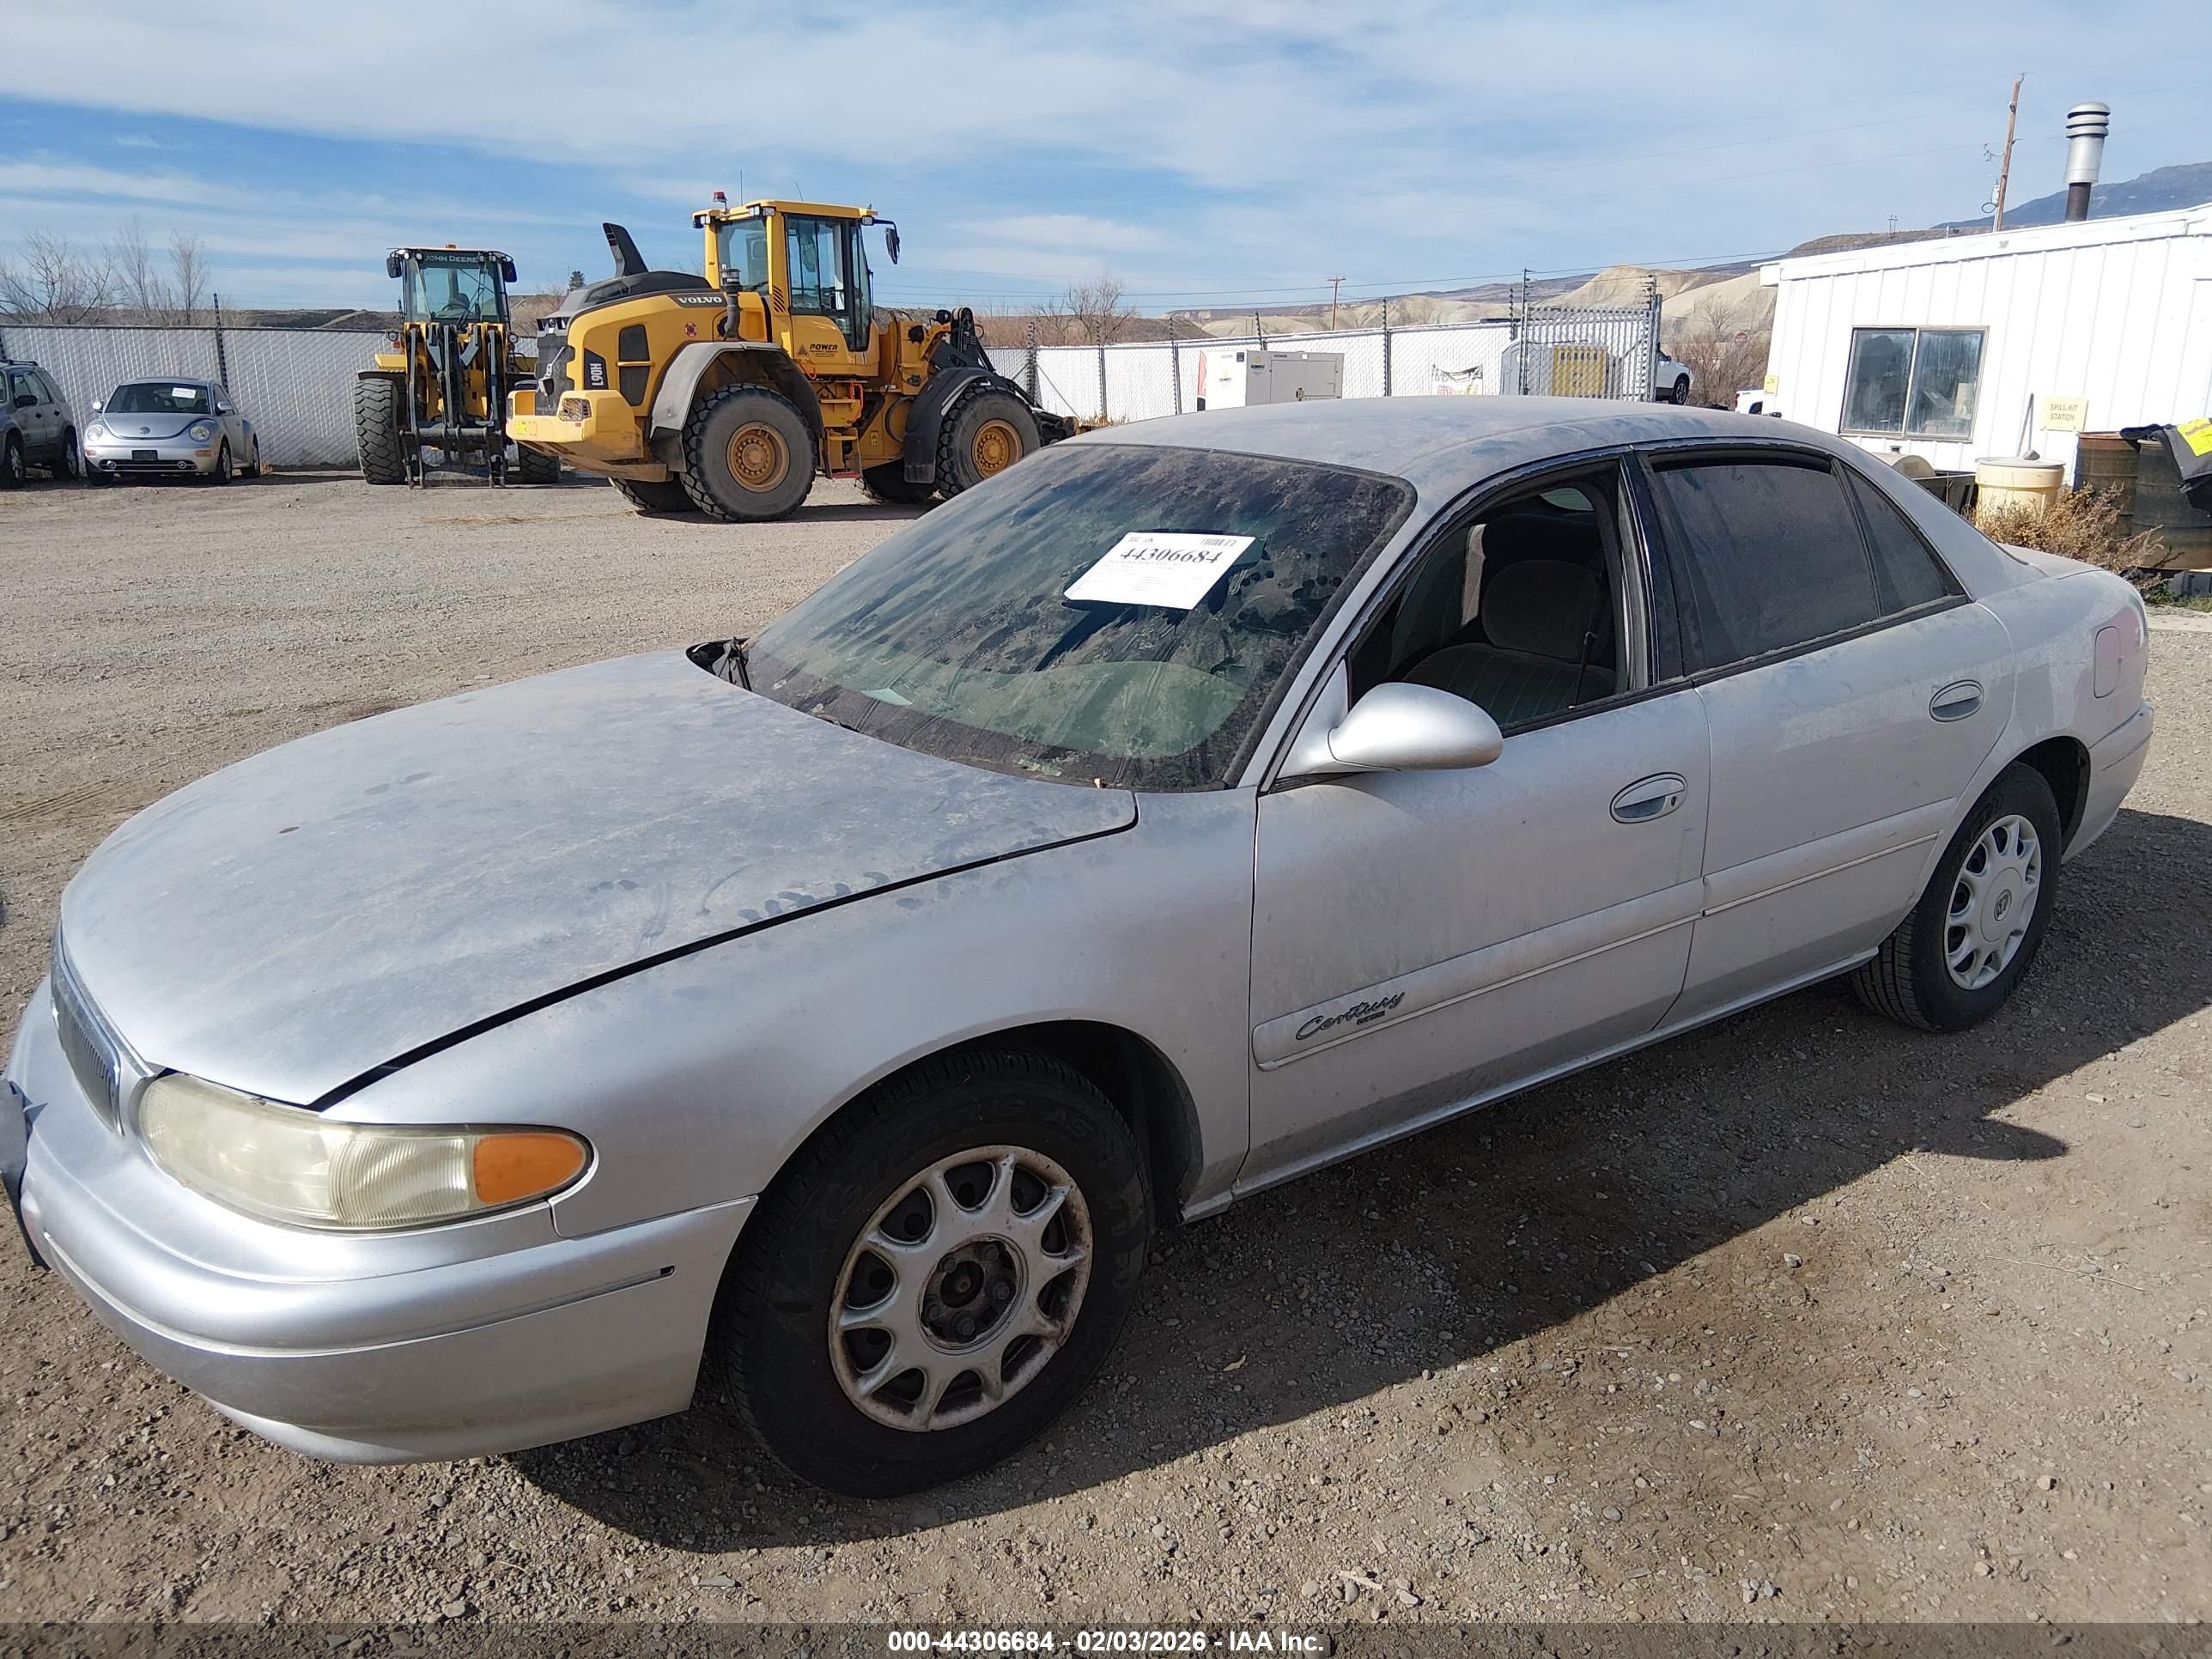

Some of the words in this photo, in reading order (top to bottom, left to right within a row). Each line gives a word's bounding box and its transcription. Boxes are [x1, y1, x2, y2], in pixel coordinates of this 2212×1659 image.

[589, 363, 604, 386] L90H
[2050, 412, 2075, 421] STATION
[1120, 548, 1223, 563] 44306684
[1295, 991, 1406, 1040] Century
